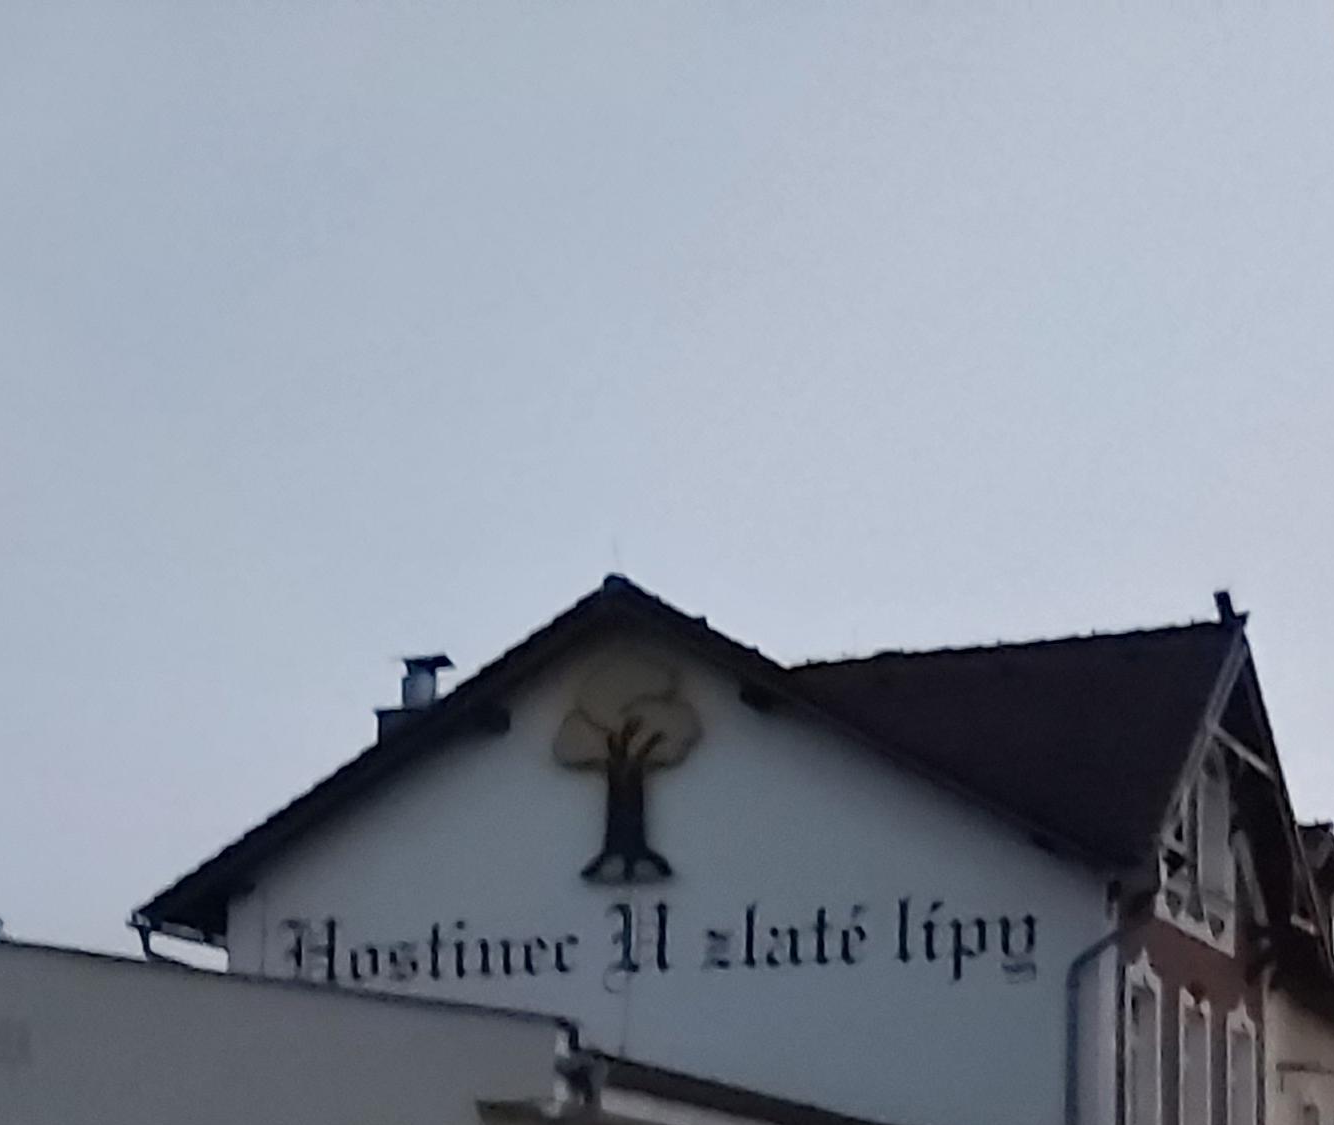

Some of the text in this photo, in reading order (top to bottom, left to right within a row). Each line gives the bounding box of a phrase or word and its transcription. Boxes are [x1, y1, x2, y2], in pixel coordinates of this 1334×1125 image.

[281, 898, 1038, 992] Hostinec U zlaté lípy
